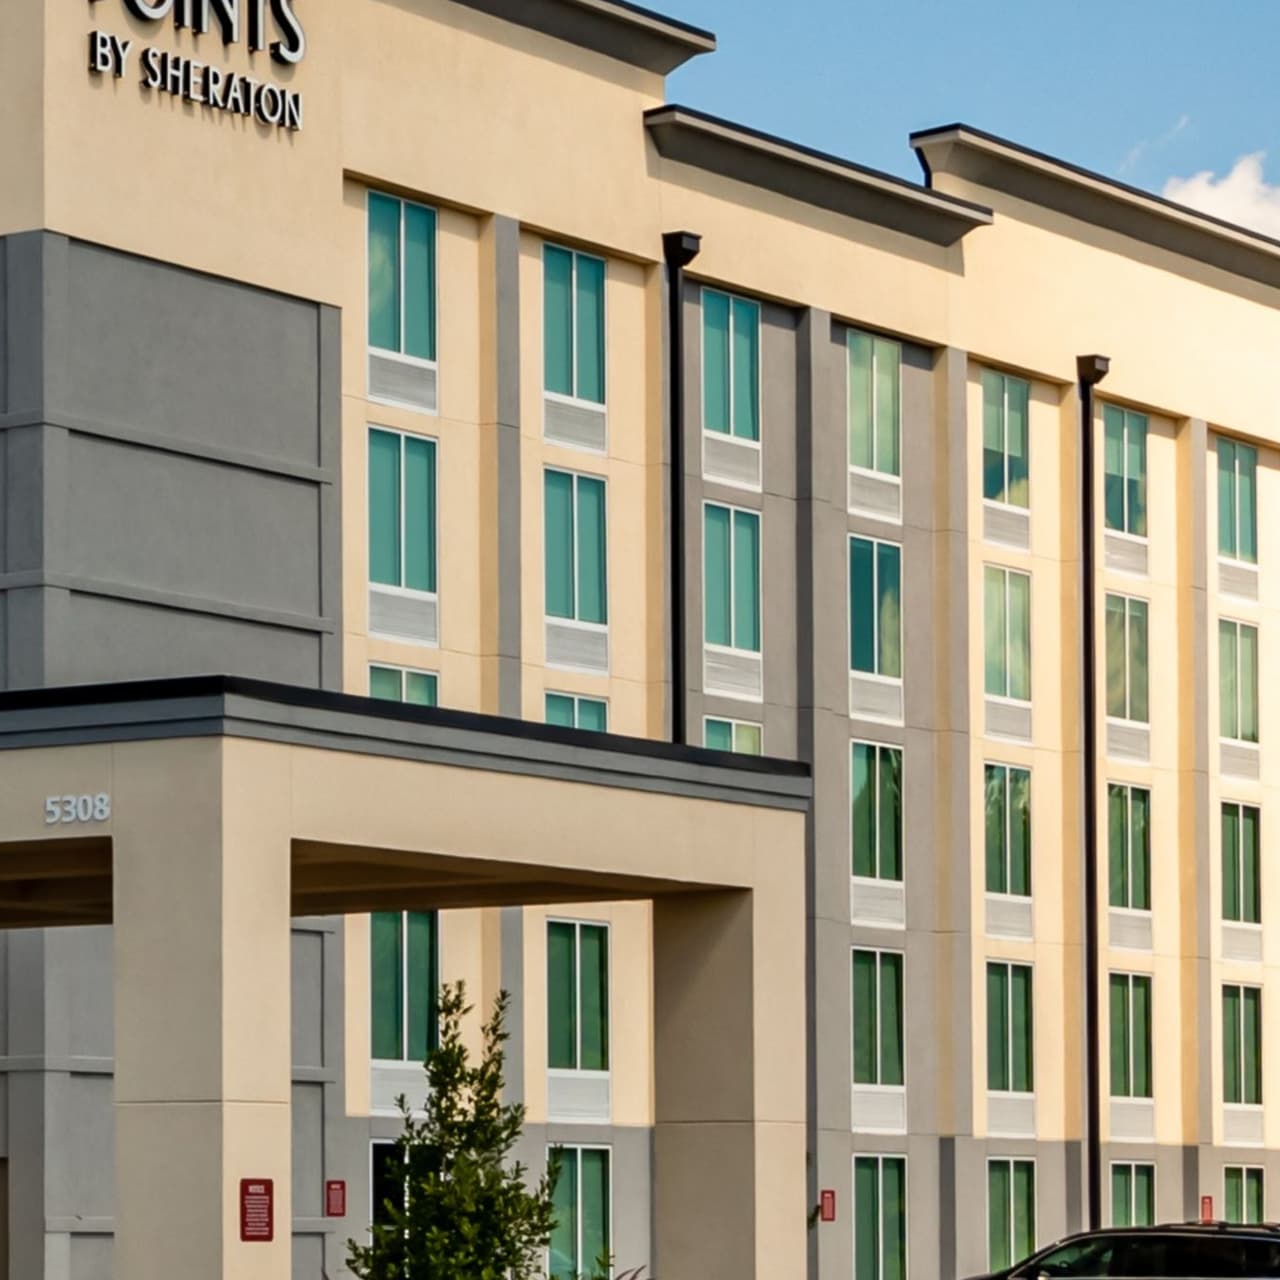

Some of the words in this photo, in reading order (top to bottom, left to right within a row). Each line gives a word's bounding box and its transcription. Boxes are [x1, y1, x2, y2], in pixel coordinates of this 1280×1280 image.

[88, 30, 134, 78] BY
[140, 47, 304, 131] SHERATON
[45, 793, 110, 824] 5308
